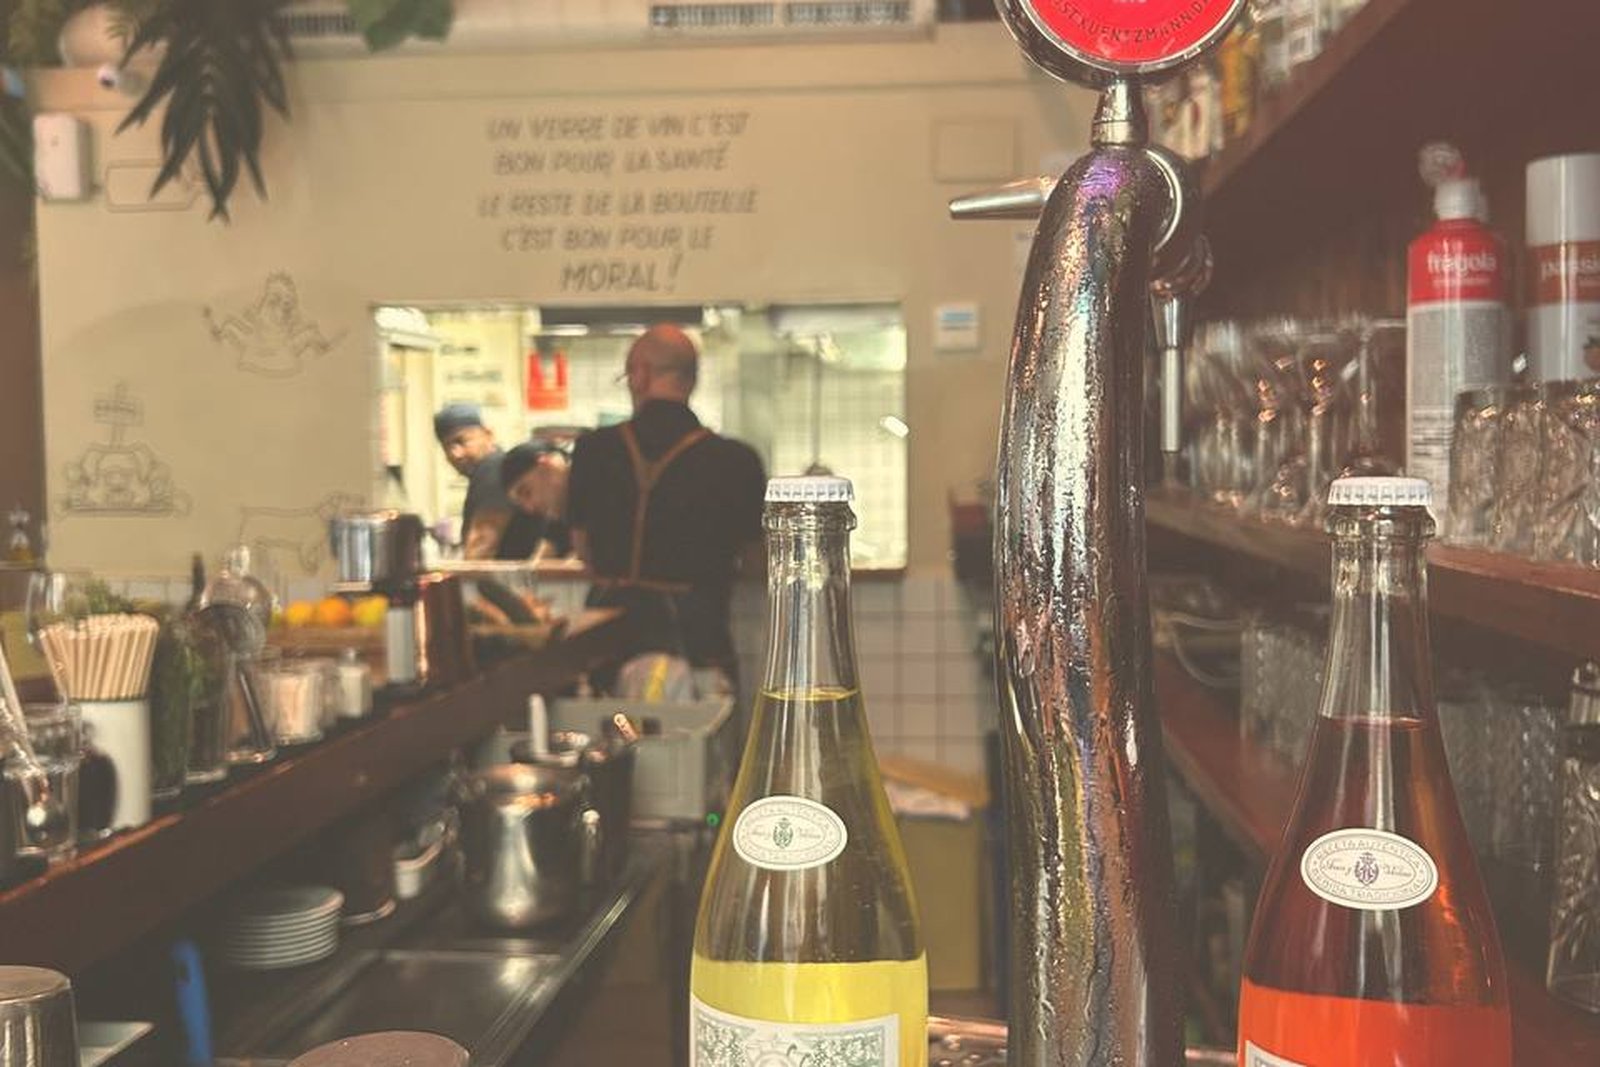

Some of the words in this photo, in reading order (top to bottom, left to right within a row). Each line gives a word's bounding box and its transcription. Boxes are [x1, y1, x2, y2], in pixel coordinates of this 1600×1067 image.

[486, 117, 521, 140] UN
[530, 116, 604, 140] VERRE
[611, 115, 640, 139] DE
[648, 114, 685, 136] VIN
[493, 150, 545, 175] BON
[551, 150, 614, 177] POUR
[622, 150, 652, 173] LA
[656, 141, 730, 171] SANTÉ
[477, 193, 504, 218] LE
[507, 192, 573, 216] RESTE
[582, 192, 613, 216] DE
[619, 191, 646, 215] LA
[651, 186, 760, 214] BOUTEILLE
[562, 227, 612, 250] BON
[619, 226, 683, 250] POUR
[688, 225, 716, 250] LE
[1427, 251, 1496, 276] fragola
